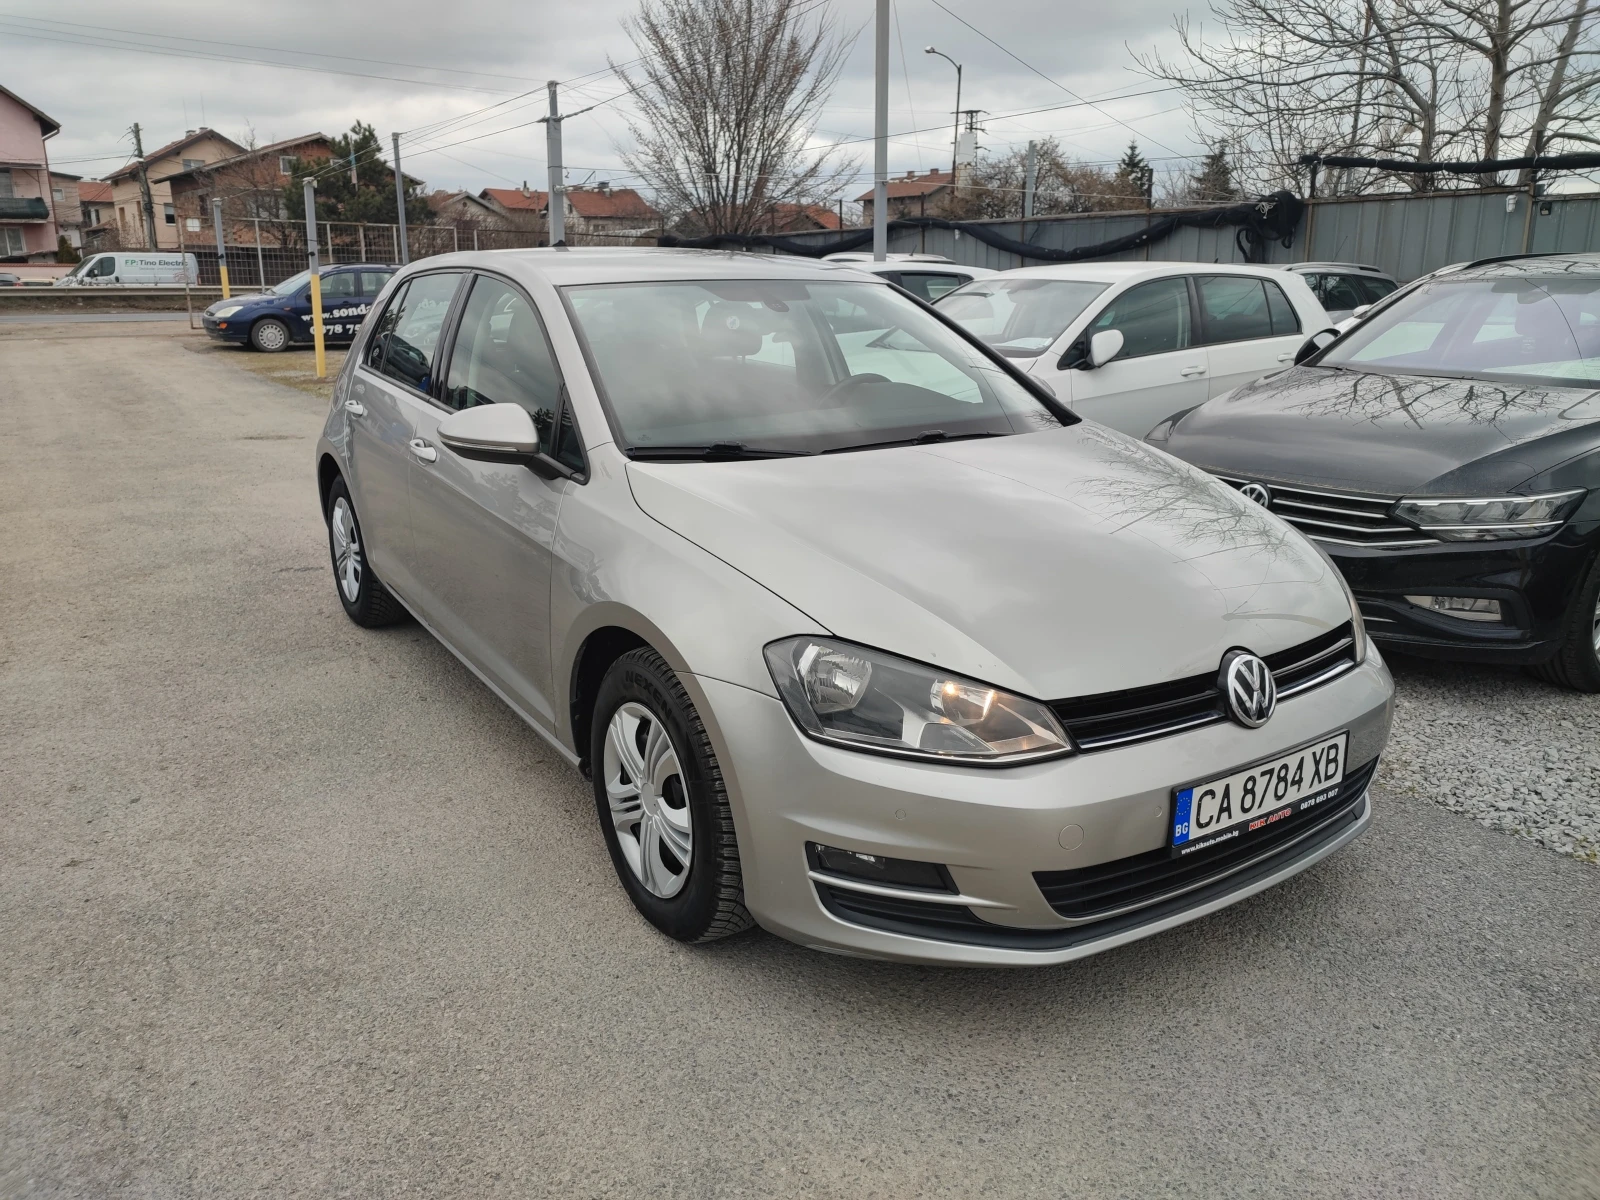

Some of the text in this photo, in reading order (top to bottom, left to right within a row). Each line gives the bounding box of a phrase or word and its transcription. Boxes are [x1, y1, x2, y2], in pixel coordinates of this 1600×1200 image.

[625, 670, 672, 720] NEXEN
[1195, 743, 1339, 828] CA 8784 XB
[1175, 822, 1188, 837] BG
[1248, 808, 1292, 831] KIK AUTO
